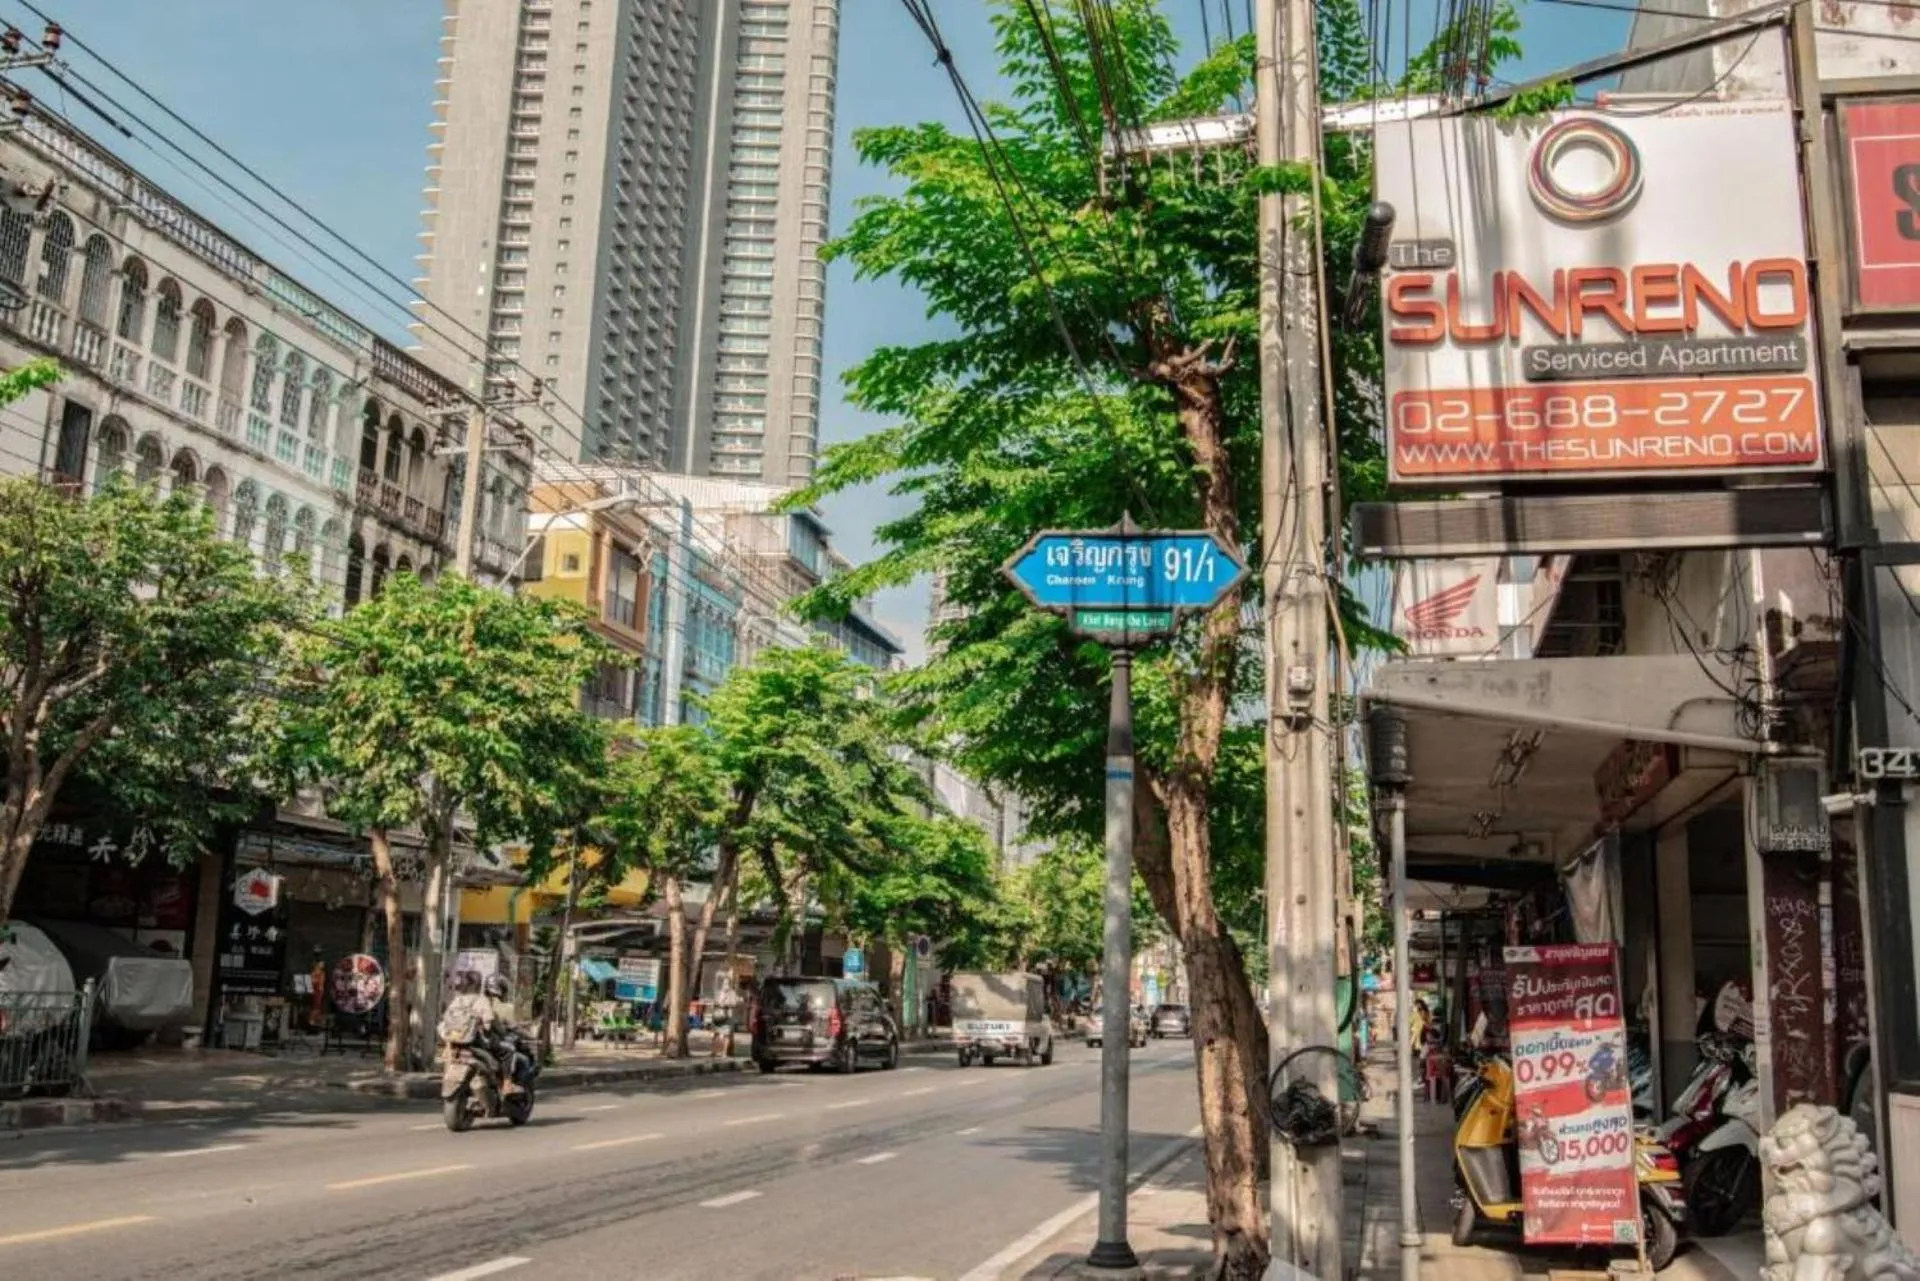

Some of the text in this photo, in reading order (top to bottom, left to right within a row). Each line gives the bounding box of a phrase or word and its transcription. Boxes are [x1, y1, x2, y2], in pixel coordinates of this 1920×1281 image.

[1393, 242, 1452, 264] The
[1387, 256, 1807, 344] SUNRENO
[1532, 340, 1800, 372] Serviced Apartment
[1399, 388, 1805, 434] 02-688-2727
[1400, 432, 1814, 464] WWW.THESUNRENO.COM
[1046, 538, 1215, 583] เจริญกรุง 91/1
[1405, 626, 1484, 641] HONDA
[1558, 1131, 1629, 1162] 15,000
